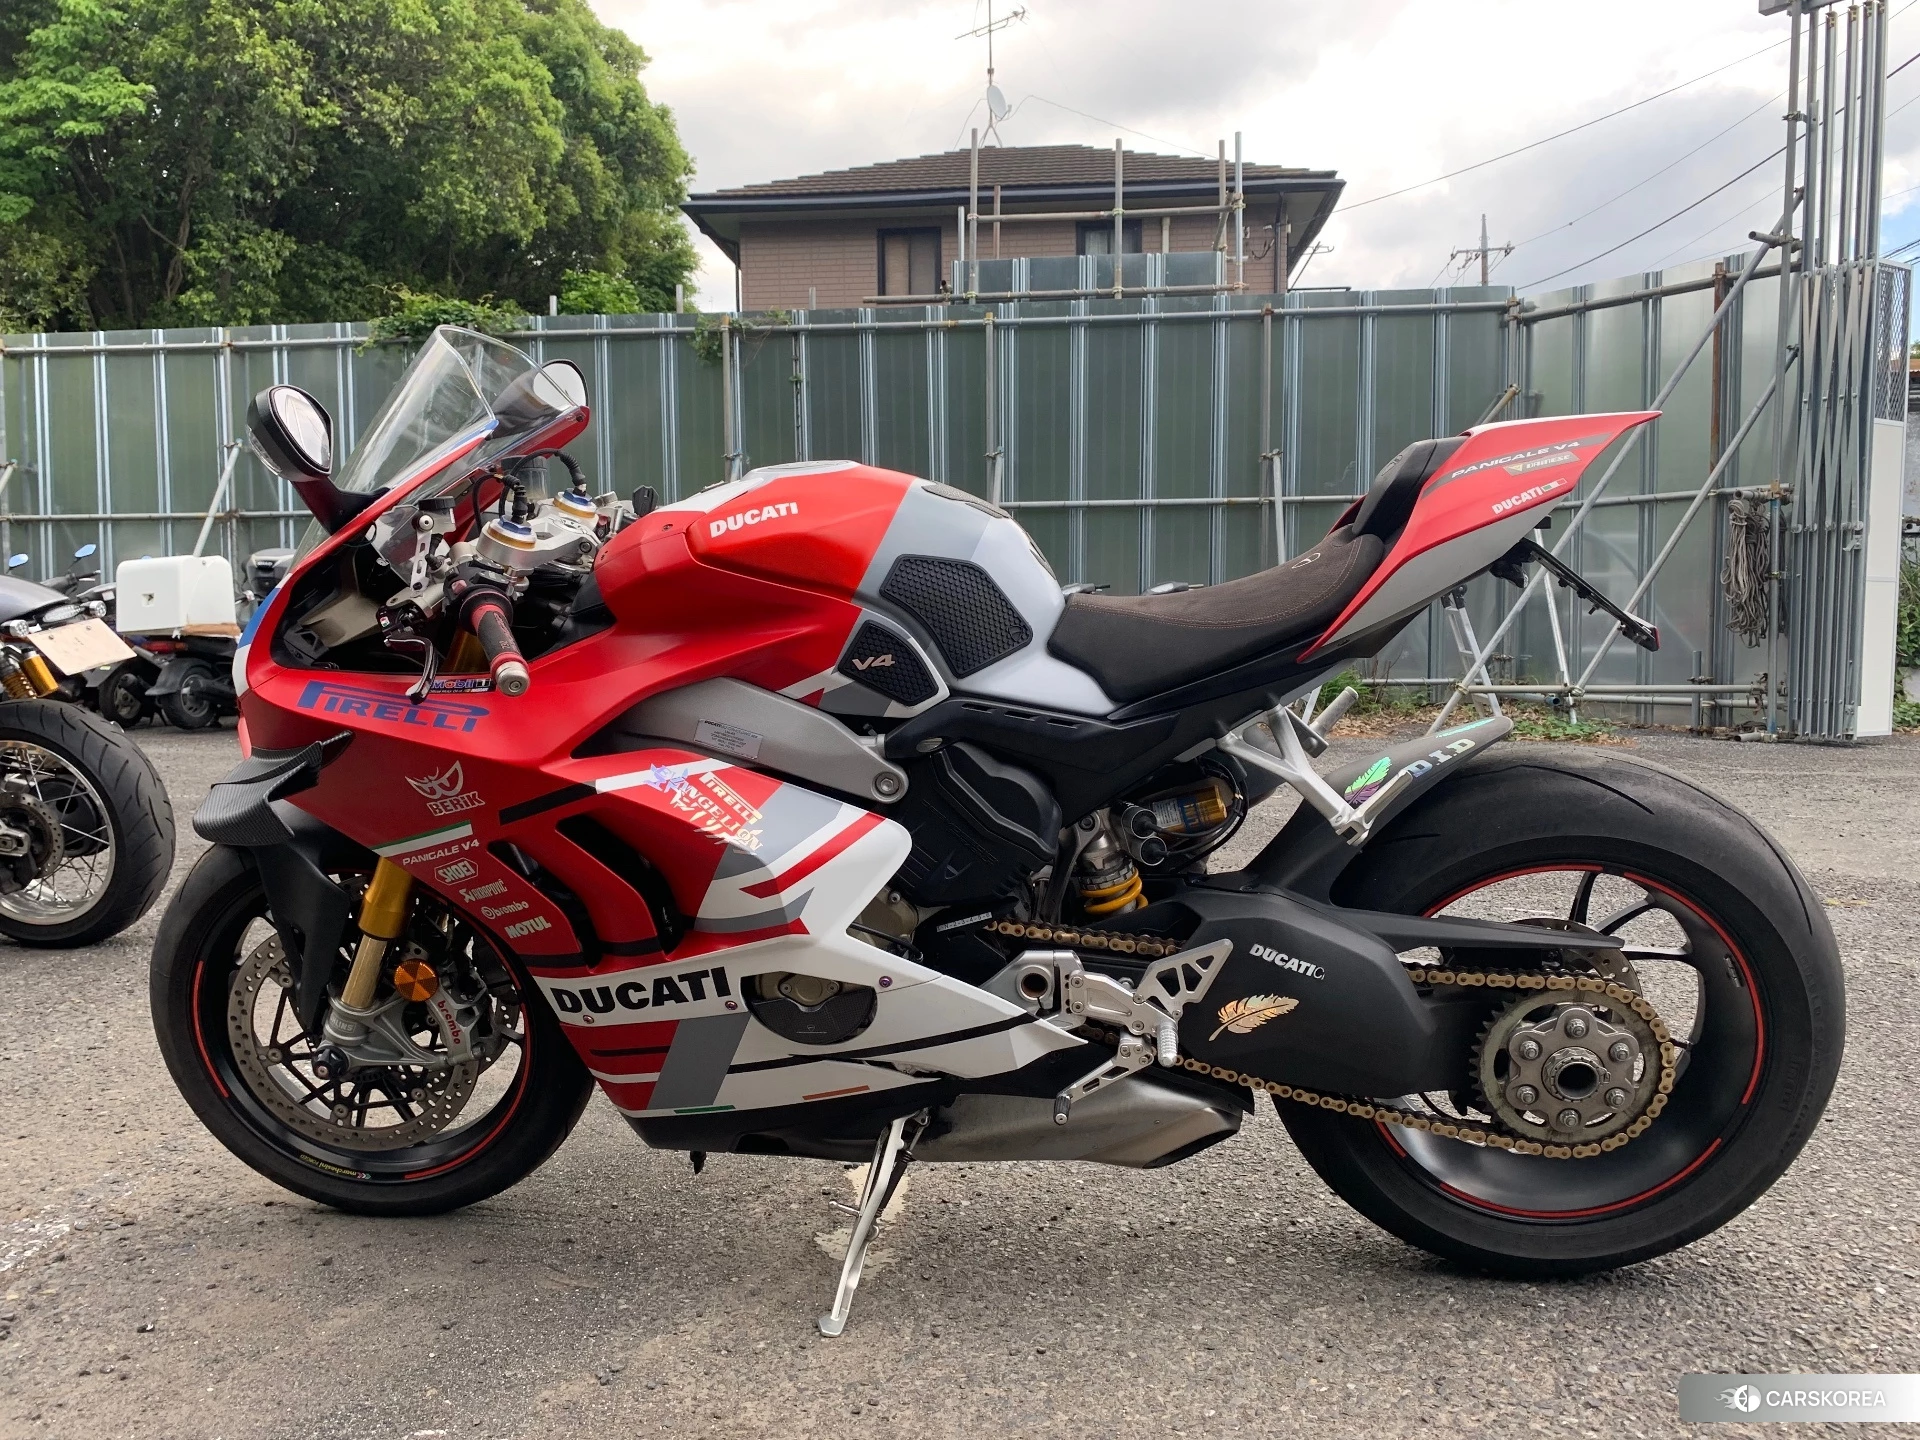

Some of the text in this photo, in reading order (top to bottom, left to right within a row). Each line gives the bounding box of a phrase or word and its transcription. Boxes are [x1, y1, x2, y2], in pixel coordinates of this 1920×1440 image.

[1451, 441, 1580, 478] PANIGALE V4
[1491, 486, 1544, 514] DUCATI
[709, 502, 799, 538] DUCATI
[852, 653, 896, 670] V4
[297, 680, 490, 732] PIRELLI
[698, 771, 763, 825] PIRELLI
[402, 838, 480, 866] PANIGALE V4
[437, 860, 476, 883] SHOEI
[495, 900, 529, 917] brembo
[504, 915, 552, 939] MOTUL
[549, 966, 732, 1014] DUCATI
[437, 999, 461, 1045] brembo
